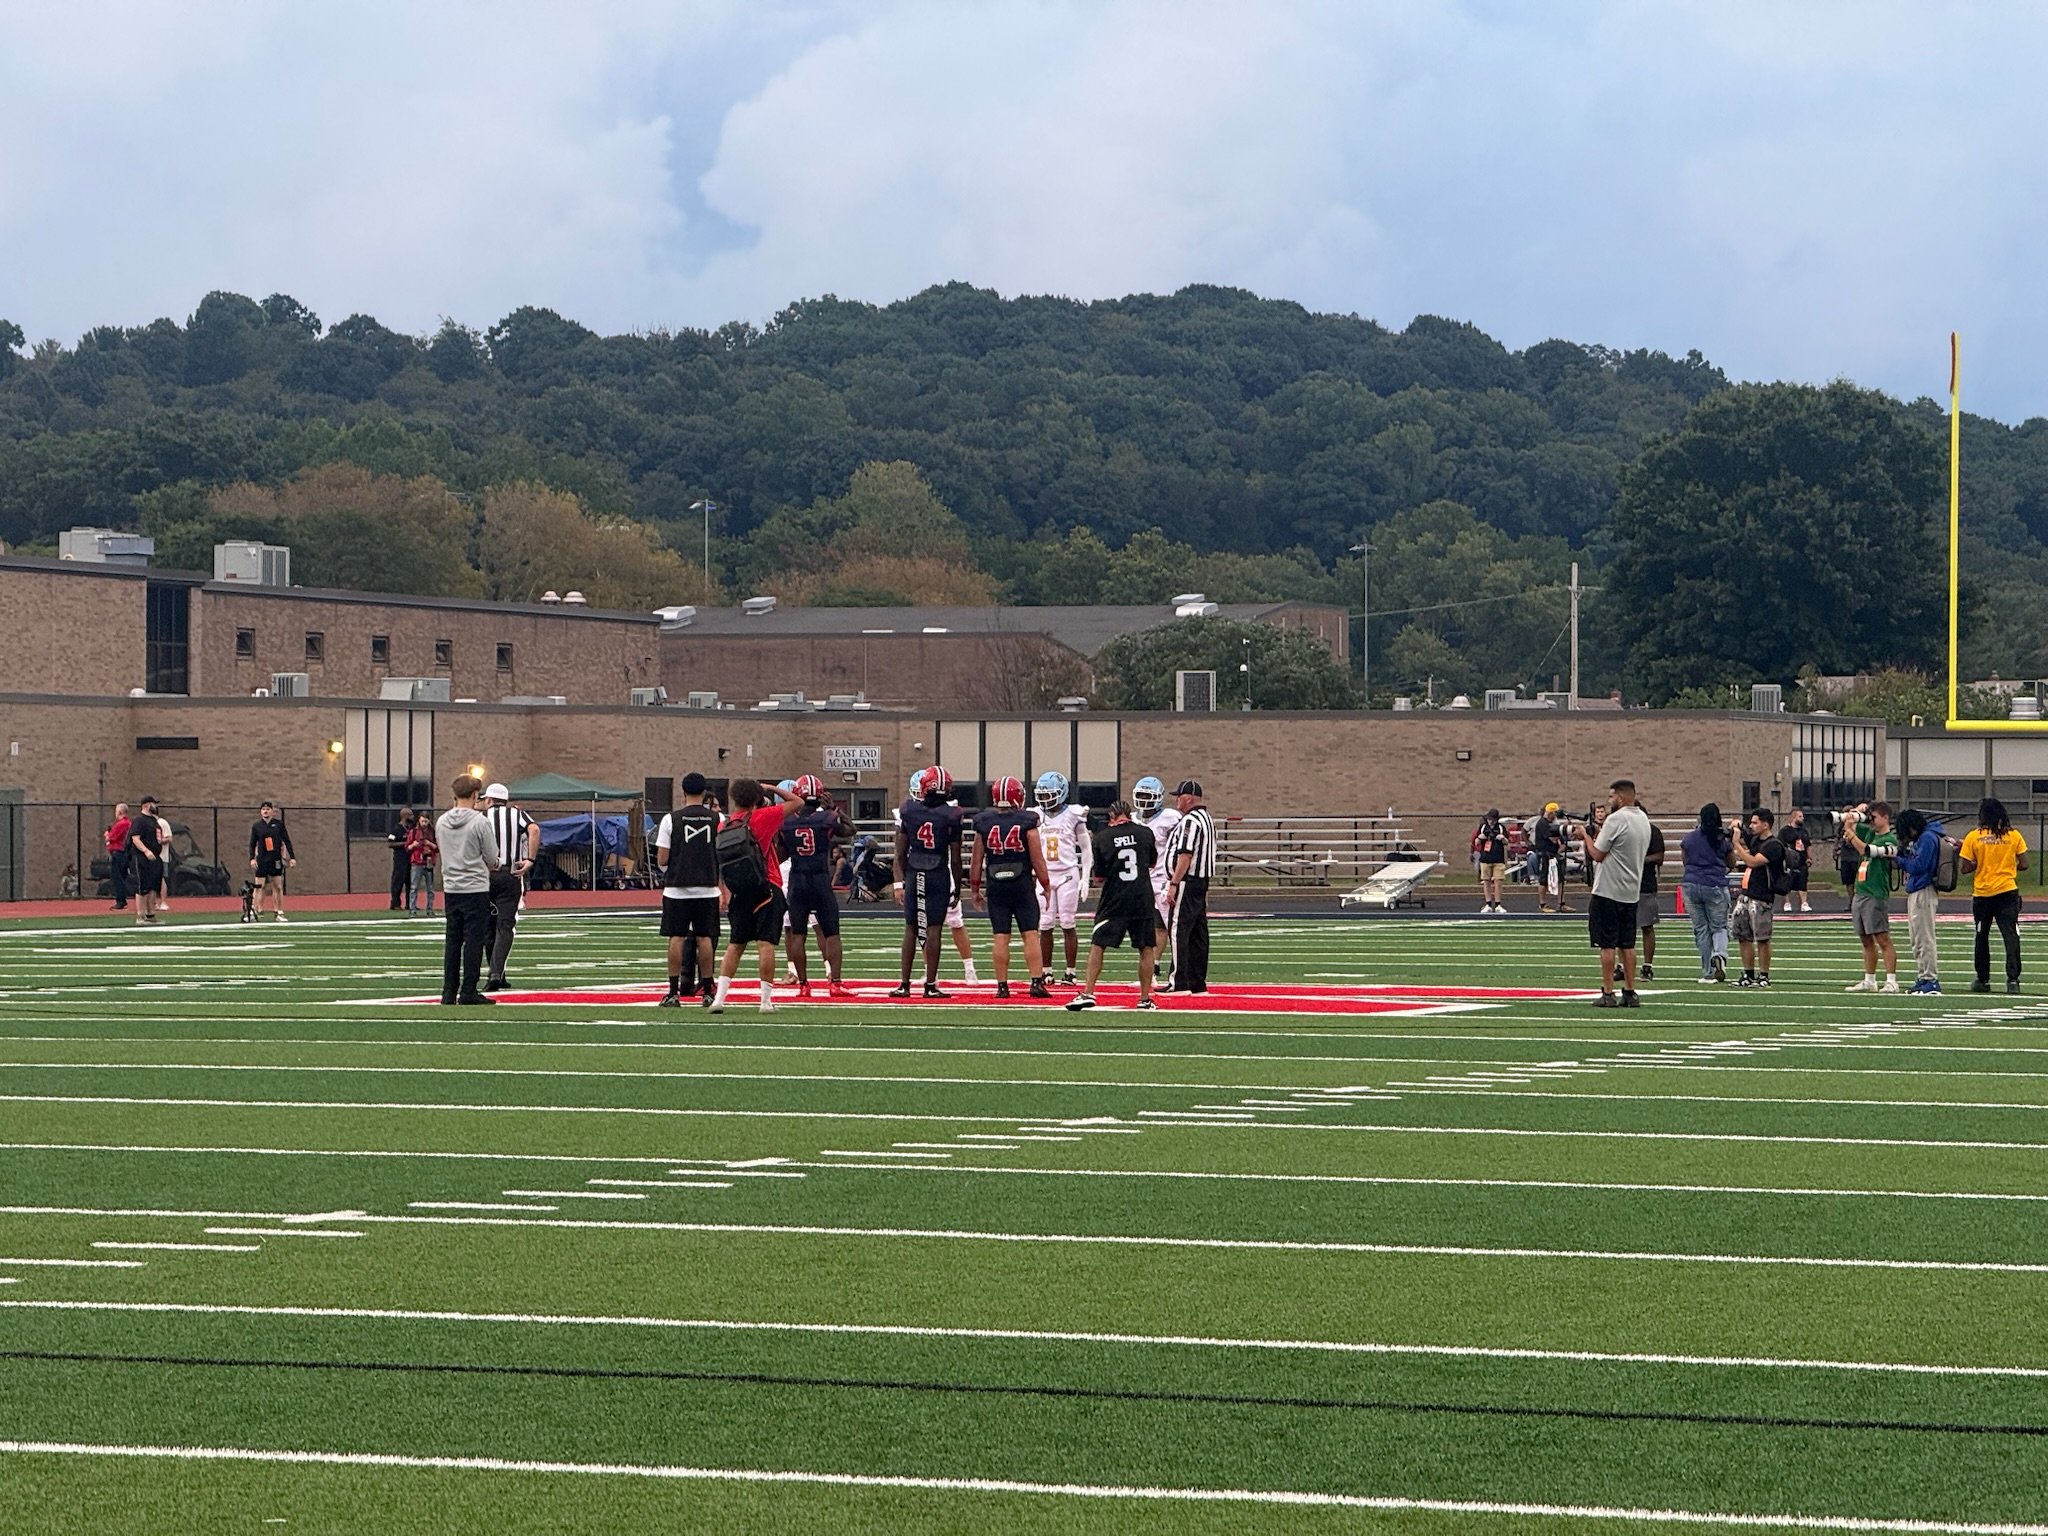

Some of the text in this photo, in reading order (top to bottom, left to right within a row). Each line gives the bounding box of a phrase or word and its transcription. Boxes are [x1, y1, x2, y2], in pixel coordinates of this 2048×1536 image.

[835, 749, 877, 758] EAST END
[827, 758, 877, 768] ACADEMY
[795, 826, 815, 856] 3
[917, 821, 935, 849] 4
[987, 825, 1025, 855] 44
[1114, 835, 1137, 847] SPELL
[1046, 837, 1059, 861] 8
[1118, 848, 1138, 881] 3
[916, 897, 926, 910] WE
[917, 911, 928, 928] GOD
[917, 928, 927, 938] IN
